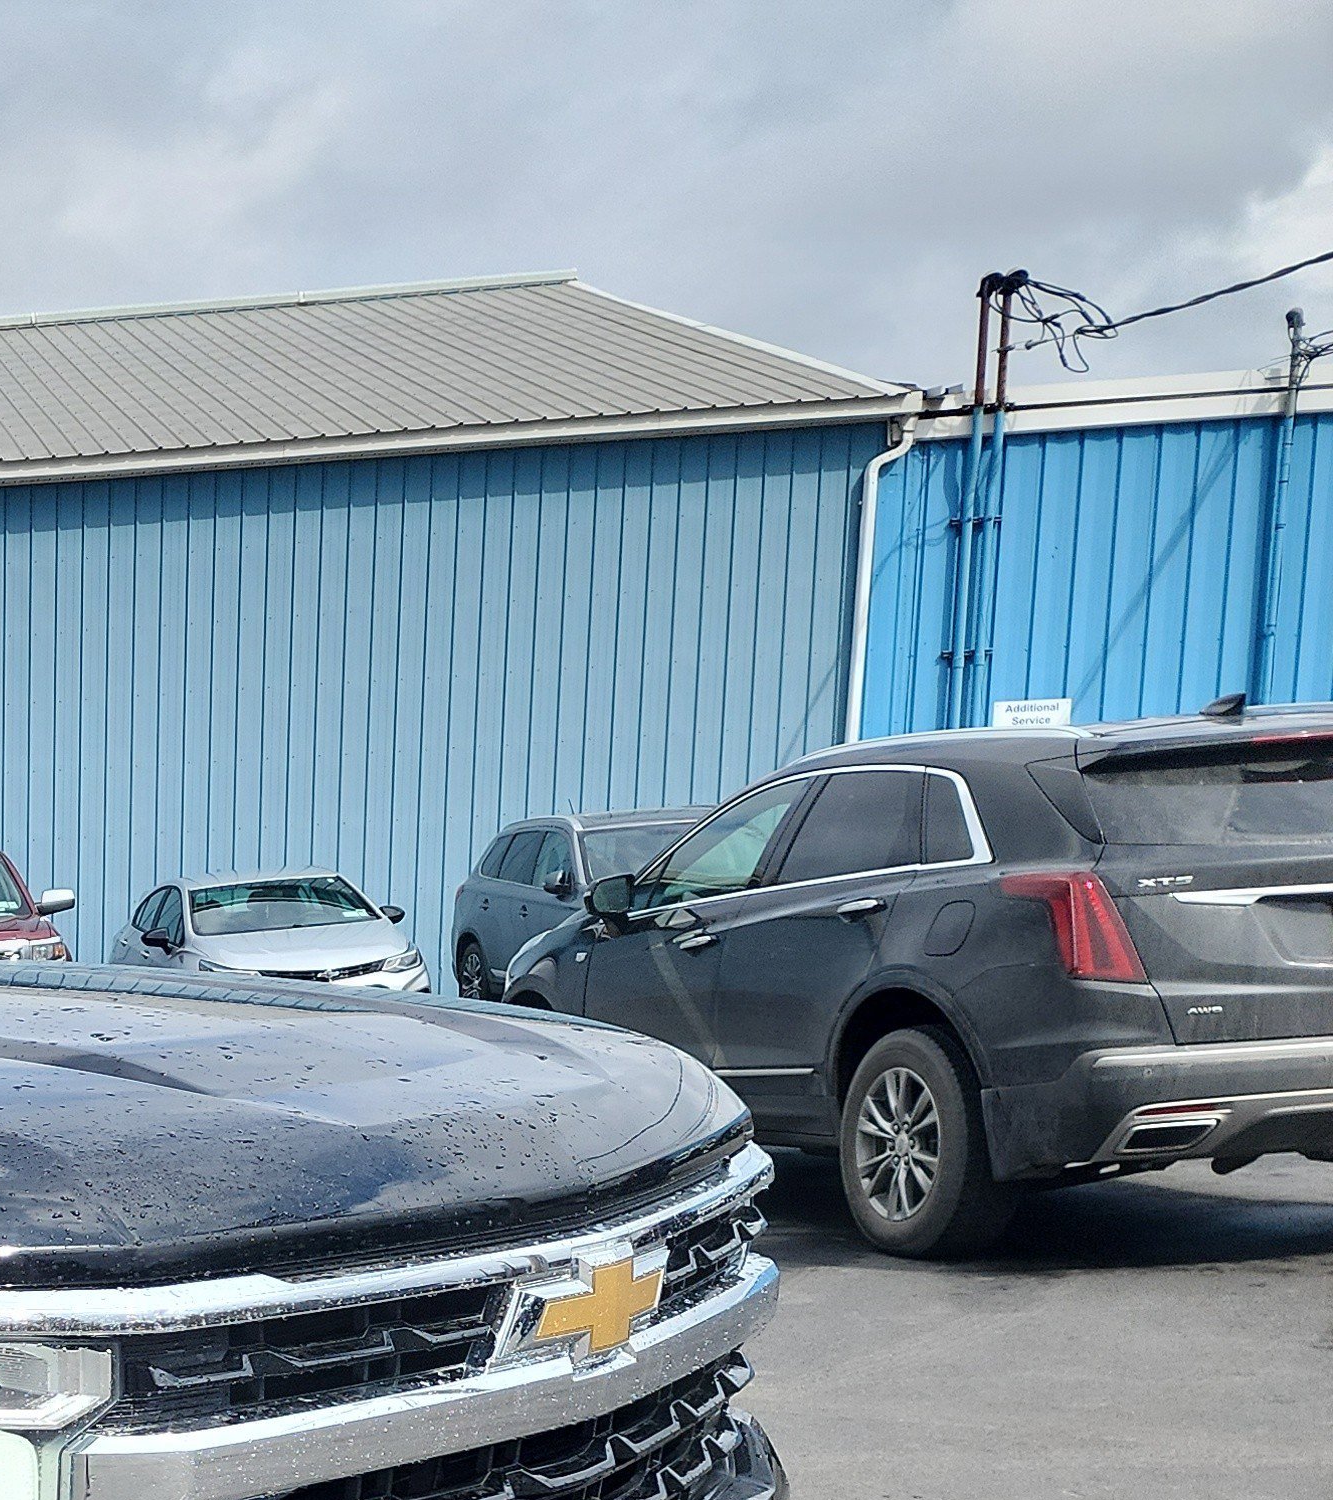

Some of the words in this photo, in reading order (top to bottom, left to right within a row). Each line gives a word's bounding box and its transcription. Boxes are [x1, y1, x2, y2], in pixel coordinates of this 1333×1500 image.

[1005, 702, 1060, 713] Additional
[1011, 716, 1051, 726] Service
[1137, 875, 1194, 888] XT5
[1187, 1005, 1224, 1015] AWD
